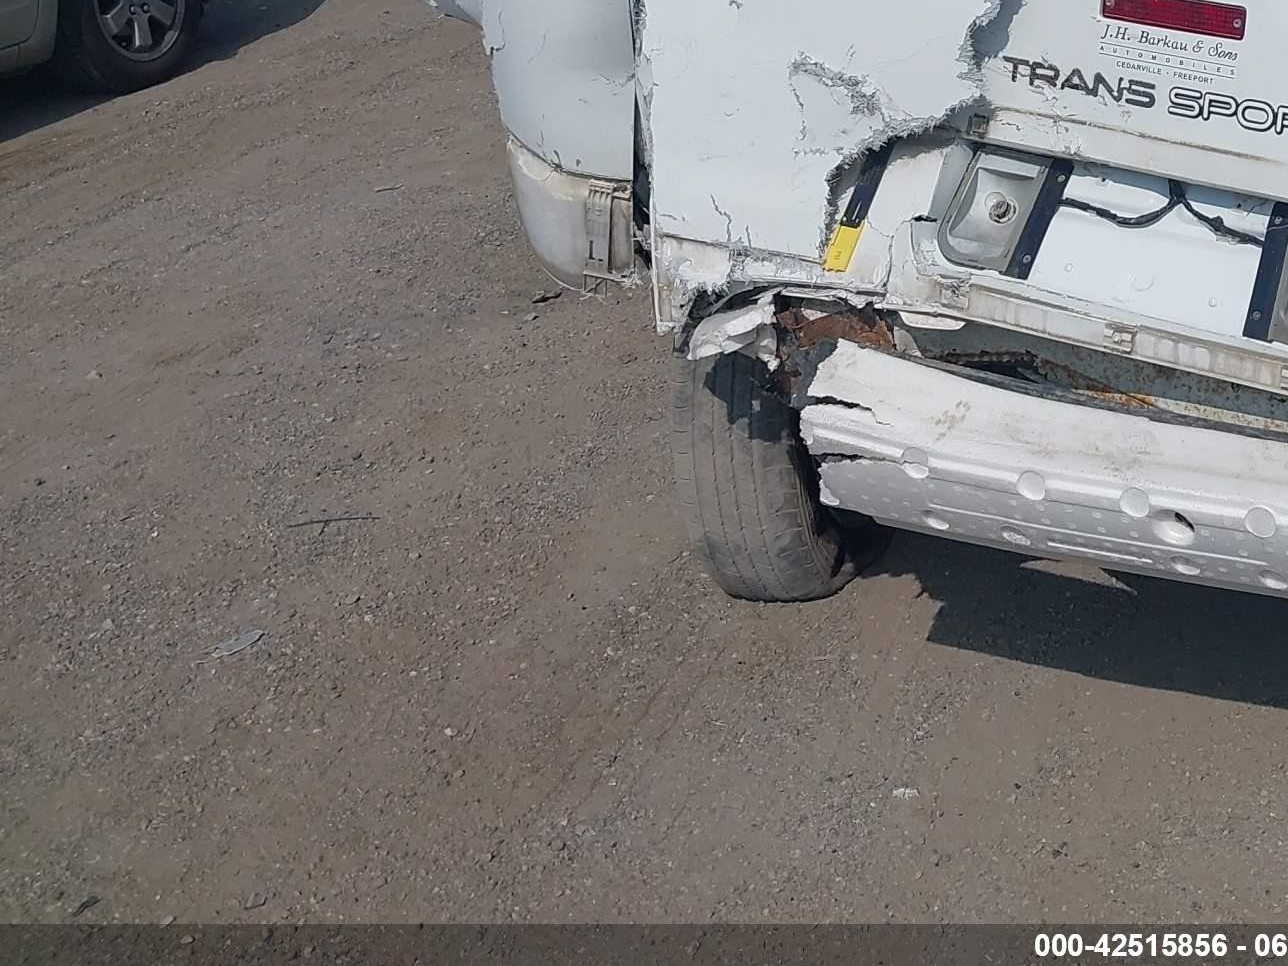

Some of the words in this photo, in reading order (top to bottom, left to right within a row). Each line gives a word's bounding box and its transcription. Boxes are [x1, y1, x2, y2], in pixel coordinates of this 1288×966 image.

[1100, 24, 1131, 41] J.H.
[1138, 30, 1188, 52] Barkau
[1192, 40, 1204, 53] &
[1207, 42, 1239, 61] Sons
[1002, 55, 1157, 109] TRANS
[1116, 60, 1162, 75] CEDARVILLE
[1173, 71, 1214, 84] FREEPORT
